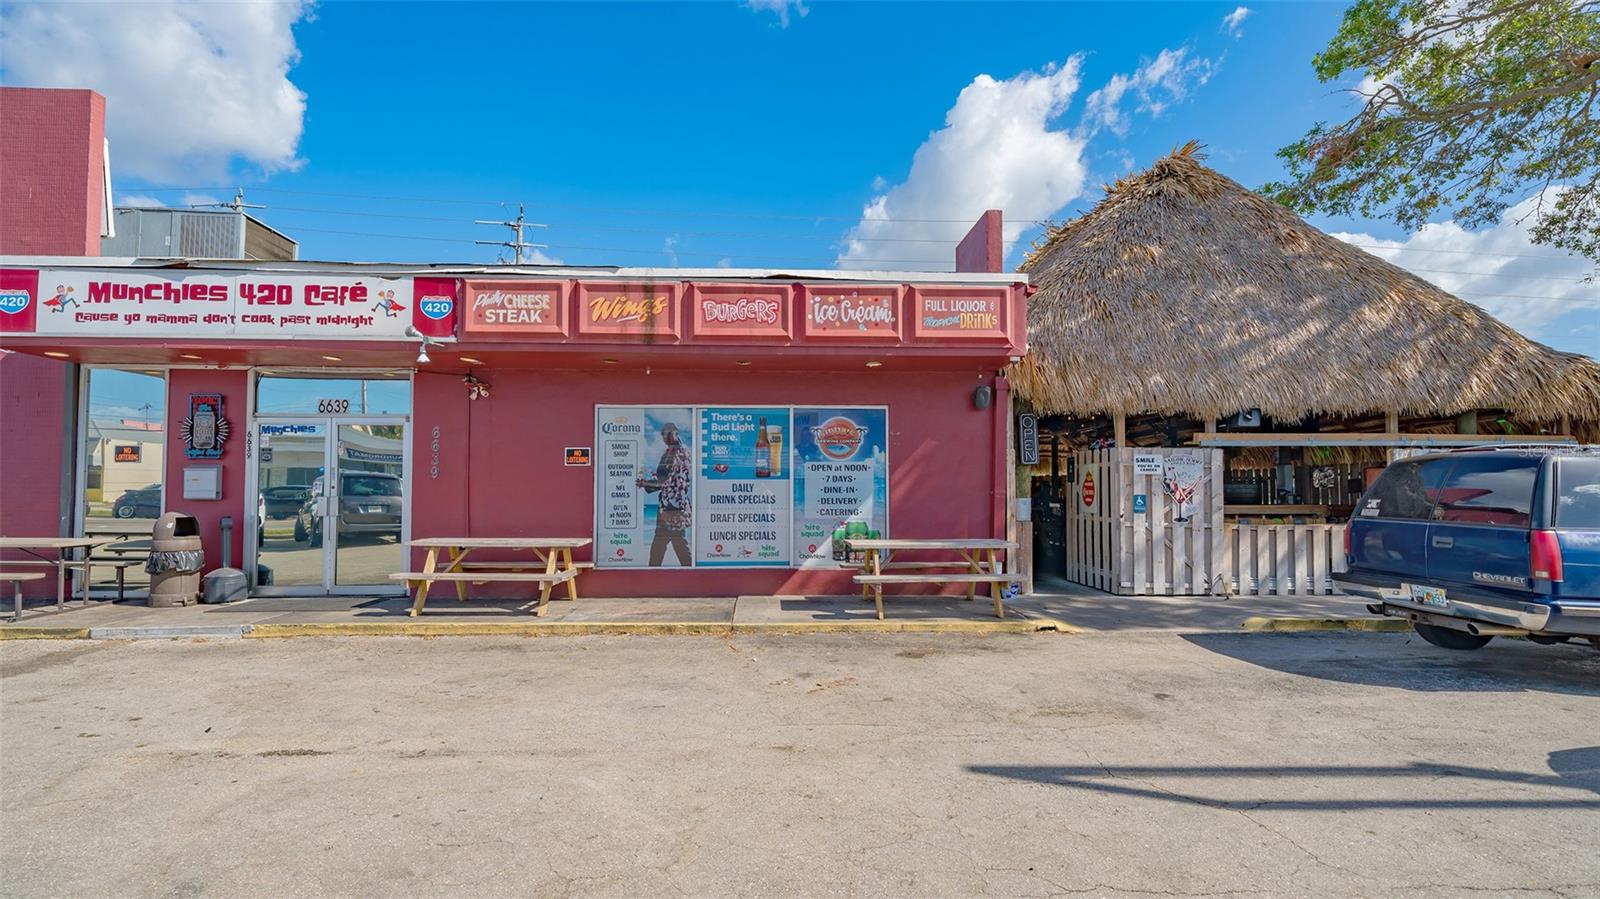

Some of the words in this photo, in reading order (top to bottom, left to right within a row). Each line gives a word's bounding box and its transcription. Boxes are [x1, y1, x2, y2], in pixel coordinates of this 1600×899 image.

[83, 281, 228, 304] Munchies
[240, 283, 293, 305] 420
[304, 281, 367, 306] Café
[0, 296, 26, 307] 420
[424, 302, 449, 313] 420
[473, 290, 506, 312] Philly
[503, 293, 550, 309] CHEESE
[925, 299, 947, 312] FULL
[950, 299, 986, 313] LIQUOR
[589, 295, 668, 323] Wings
[814, 300, 838, 323] Ice
[124, 314, 141, 325] yo
[146, 313, 197, 324] mamma
[203, 314, 236, 325] don't
[280, 315, 311, 327] past
[316, 314, 374, 328] midnight
[485, 308, 542, 324] STEAK
[318, 399, 349, 414] 6639
[711, 413, 744, 421] There's
[601, 422, 641, 435] Corona
[731, 423, 755, 432] Light
[711, 433, 738, 441] there.
[1022, 416, 1035, 462] OPEN
[431, 426, 441, 480] 6639
[732, 483, 754, 493] DAILY
[710, 495, 737, 504] DRINK
[738, 495, 776, 505] SPECIALS
[710, 513, 736, 523] DRAFT
[738, 513, 776, 523] SPECIALS
[819, 508, 859, 516] CATERING
[709, 531, 737, 541] LUNCH
[738, 531, 776, 541] SPECIALS
[800, 530, 824, 538] squad
[1472, 571, 1526, 584] CHEVROLET
